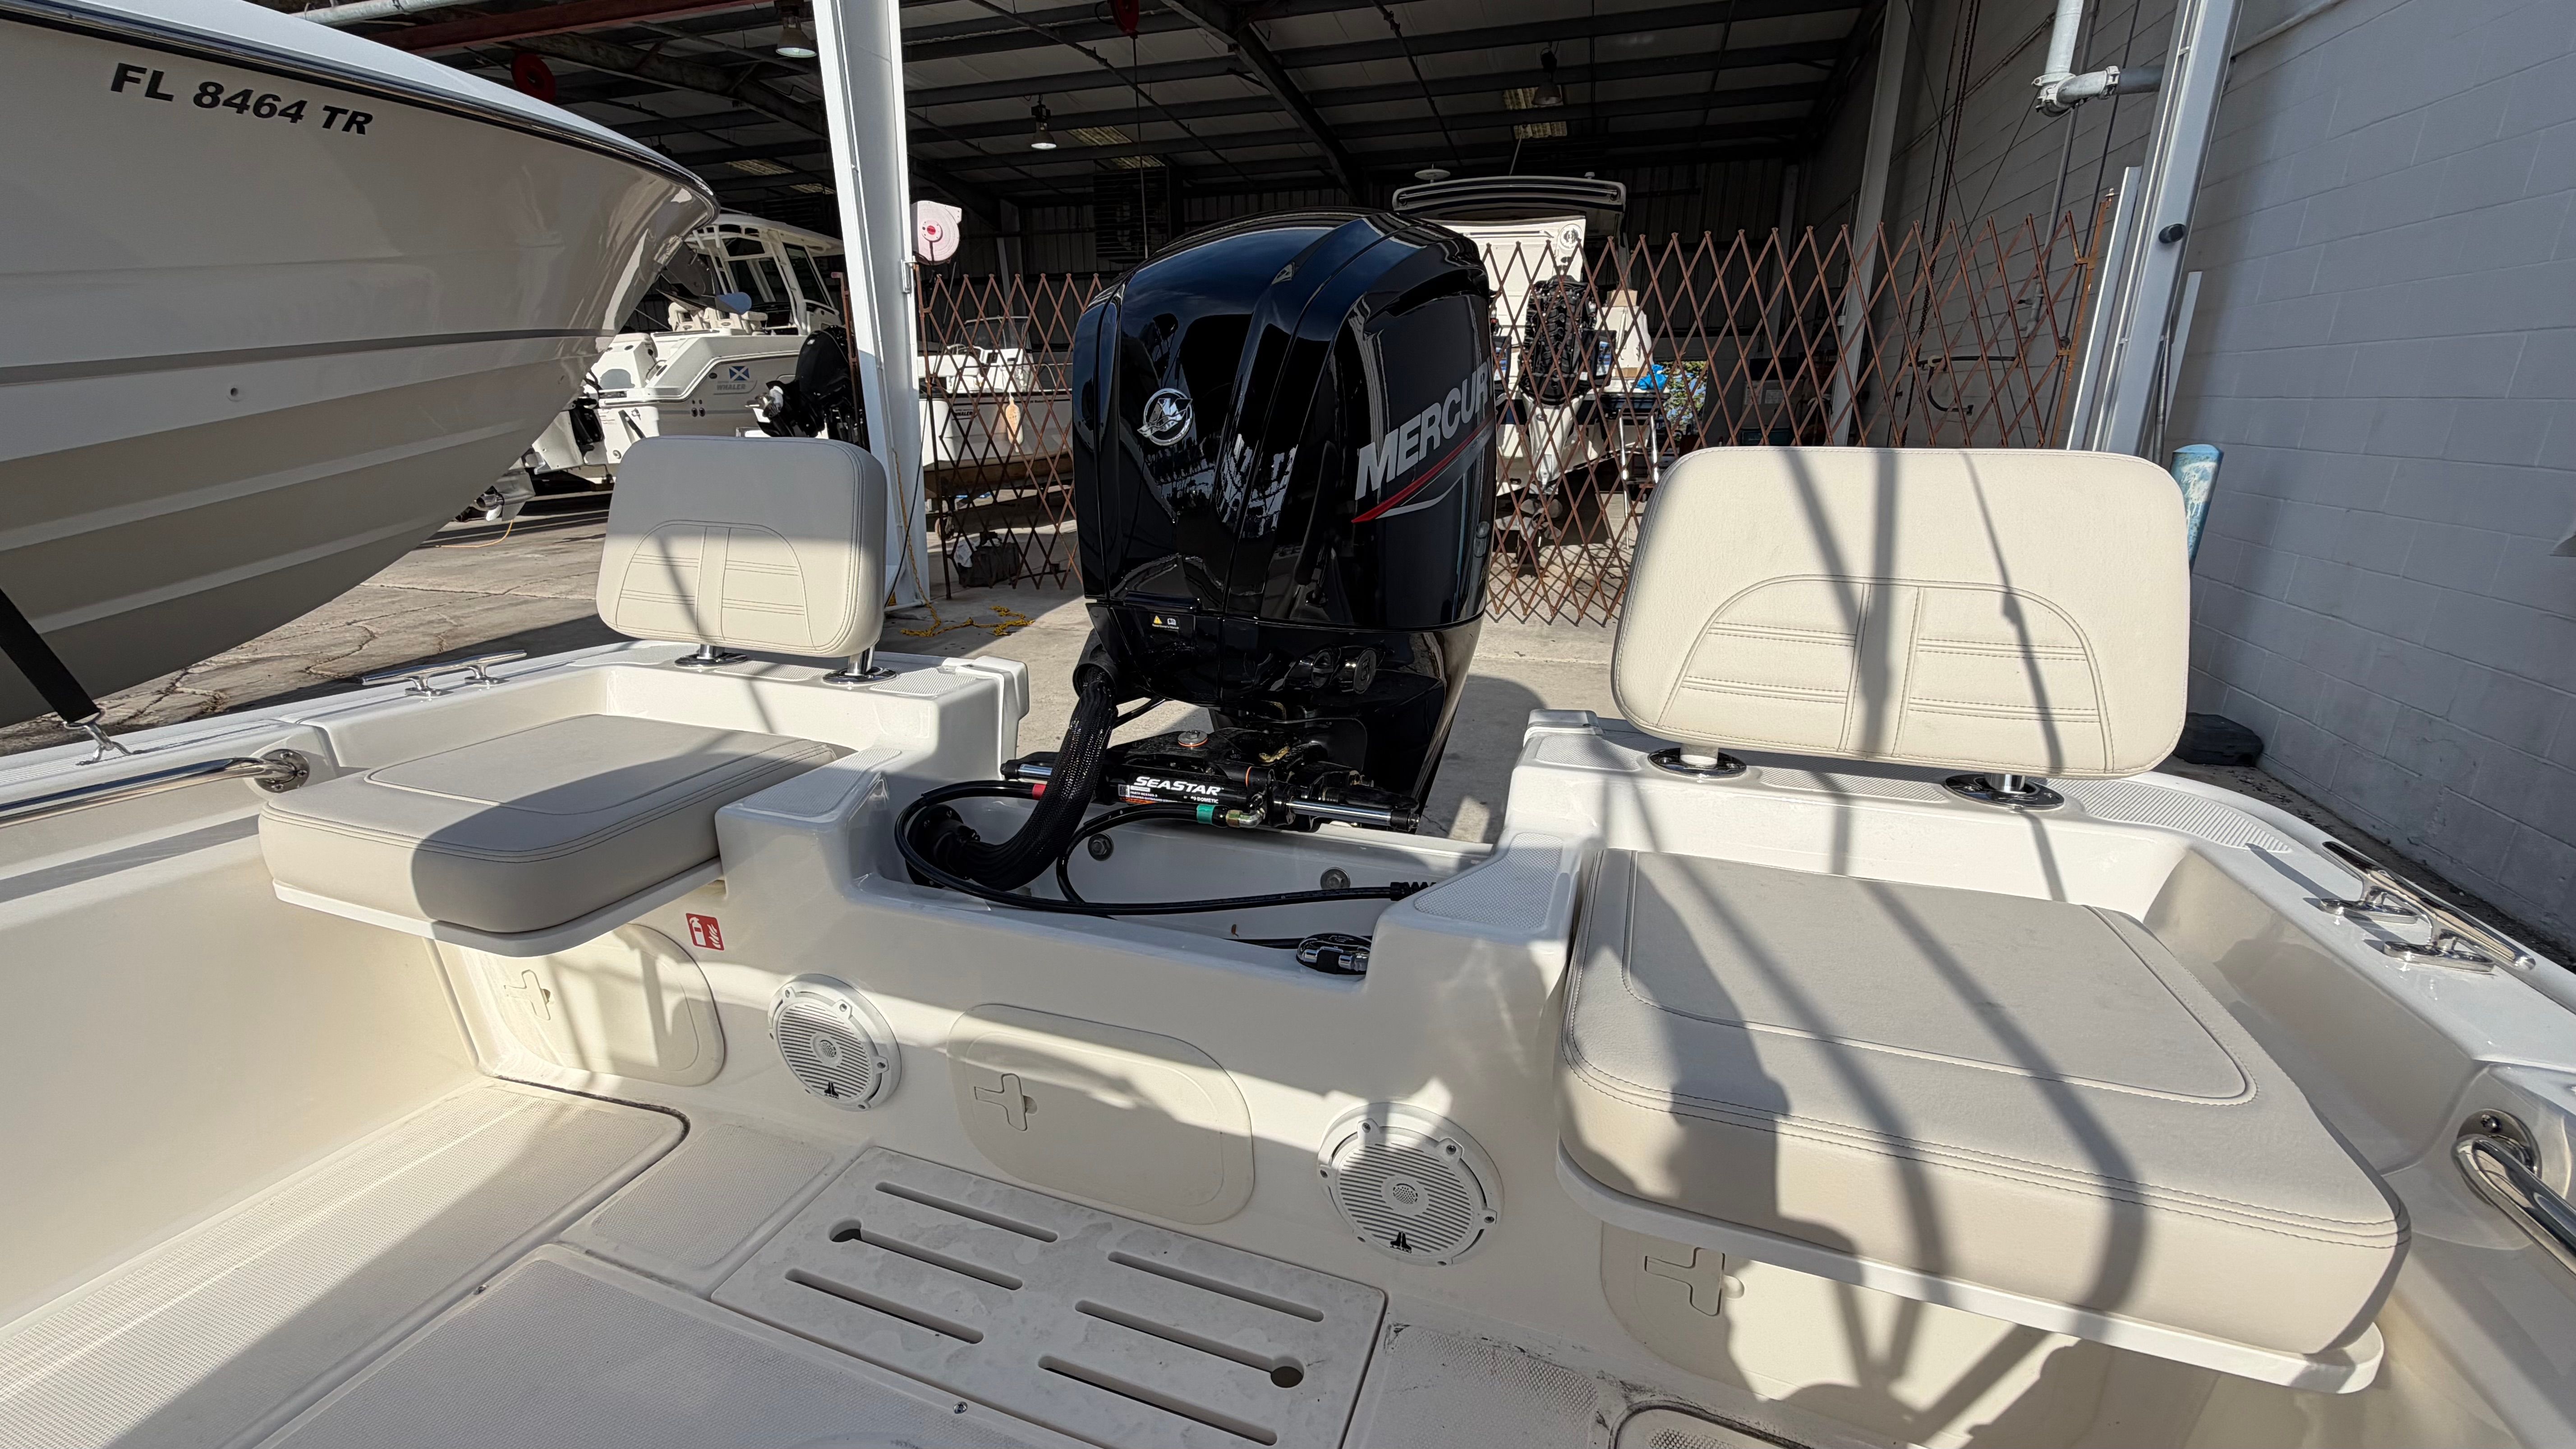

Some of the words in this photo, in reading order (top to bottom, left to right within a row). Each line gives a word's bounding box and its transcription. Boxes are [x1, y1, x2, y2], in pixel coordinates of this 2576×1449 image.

[110, 62, 175, 102] FL
[193, 81, 308, 124] 8464
[322, 105, 373, 135] TR
